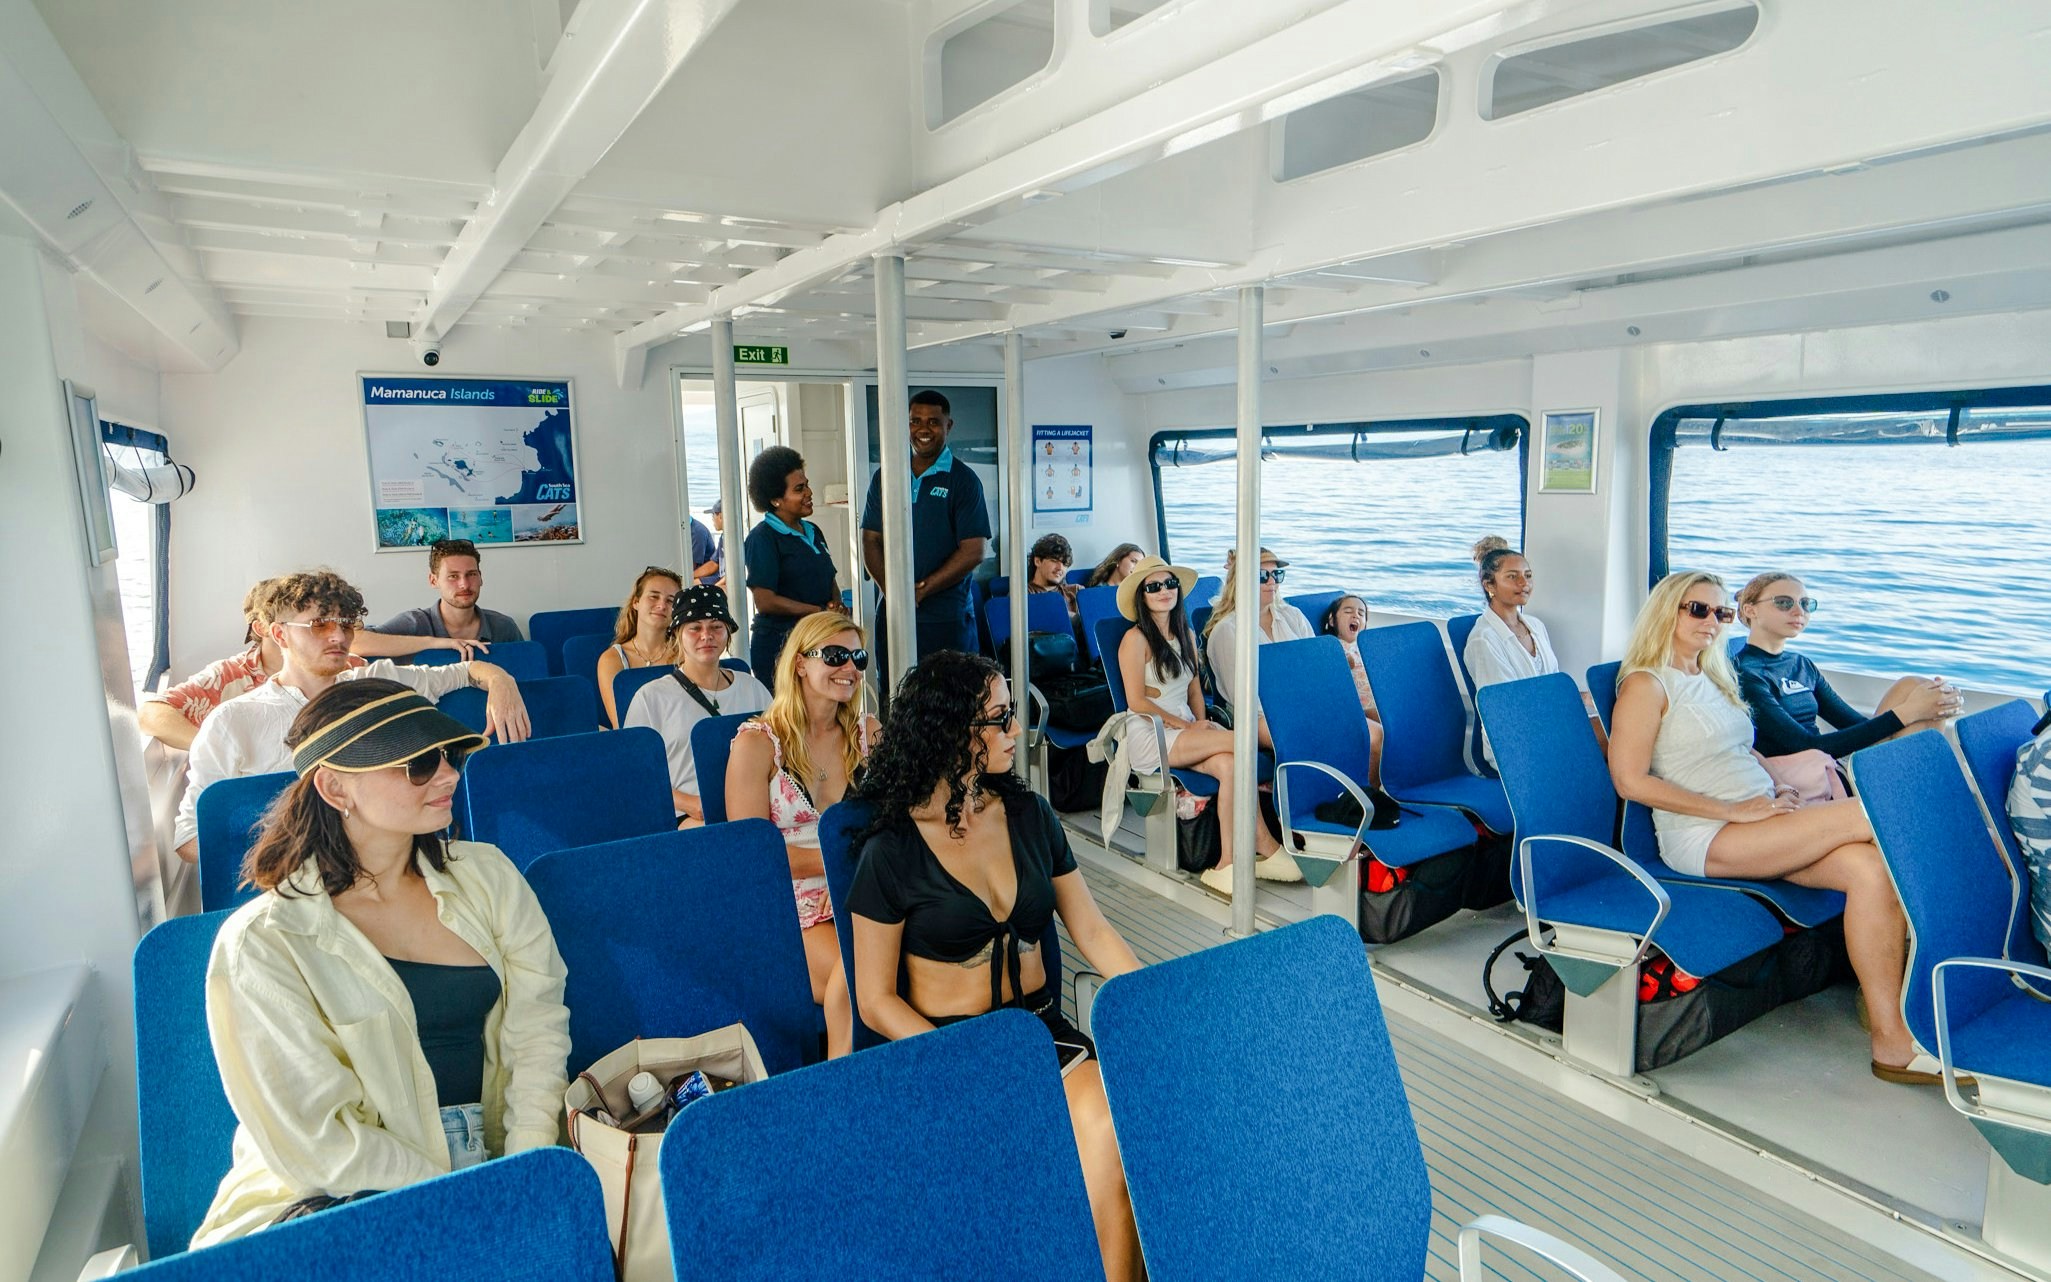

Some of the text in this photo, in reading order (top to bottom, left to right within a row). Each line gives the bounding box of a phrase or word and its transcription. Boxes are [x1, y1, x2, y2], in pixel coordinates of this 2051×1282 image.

[739, 348, 765, 361] Exit
[370, 386, 495, 400] Mamanuca Islands
[528, 394, 559, 403] SLIDE
[1569, 423, 1584, 435] 20
[536, 483, 571, 500] CATS
[930, 486, 947, 499] CATS
